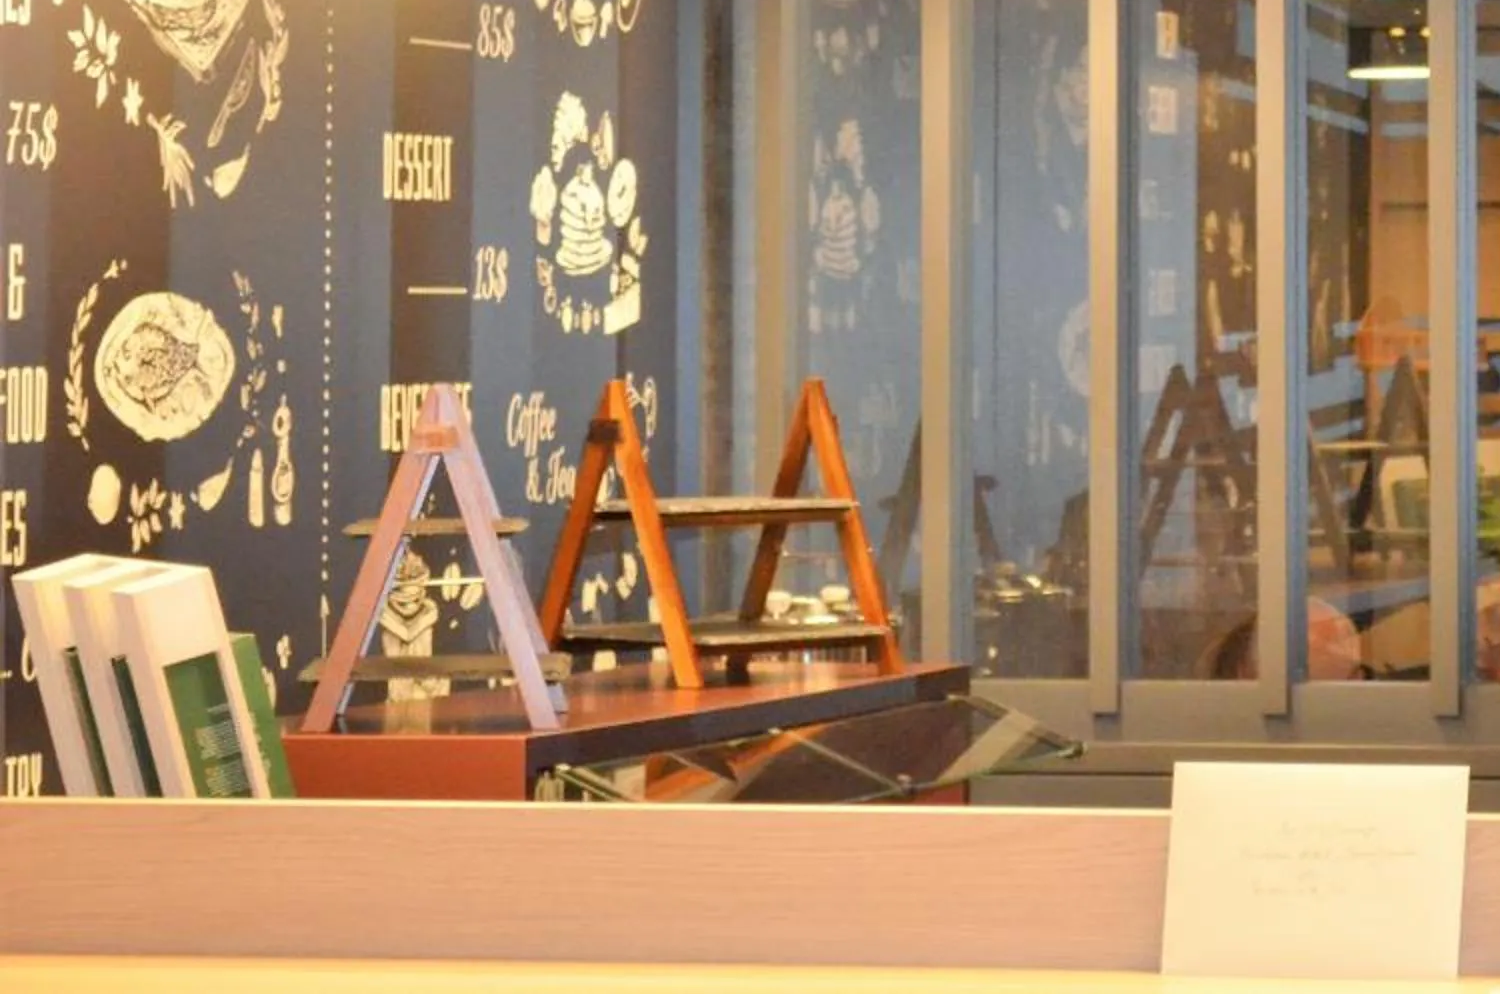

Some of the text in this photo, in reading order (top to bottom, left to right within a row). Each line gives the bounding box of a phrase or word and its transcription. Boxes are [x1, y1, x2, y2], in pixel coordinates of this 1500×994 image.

[477, 2, 515, 63] 85$
[6, 99, 59, 171] 75$
[383, 132, 453, 202] DESSERT
[472, 246, 508, 303] 13$
[507, 391, 557, 458] Coffee
